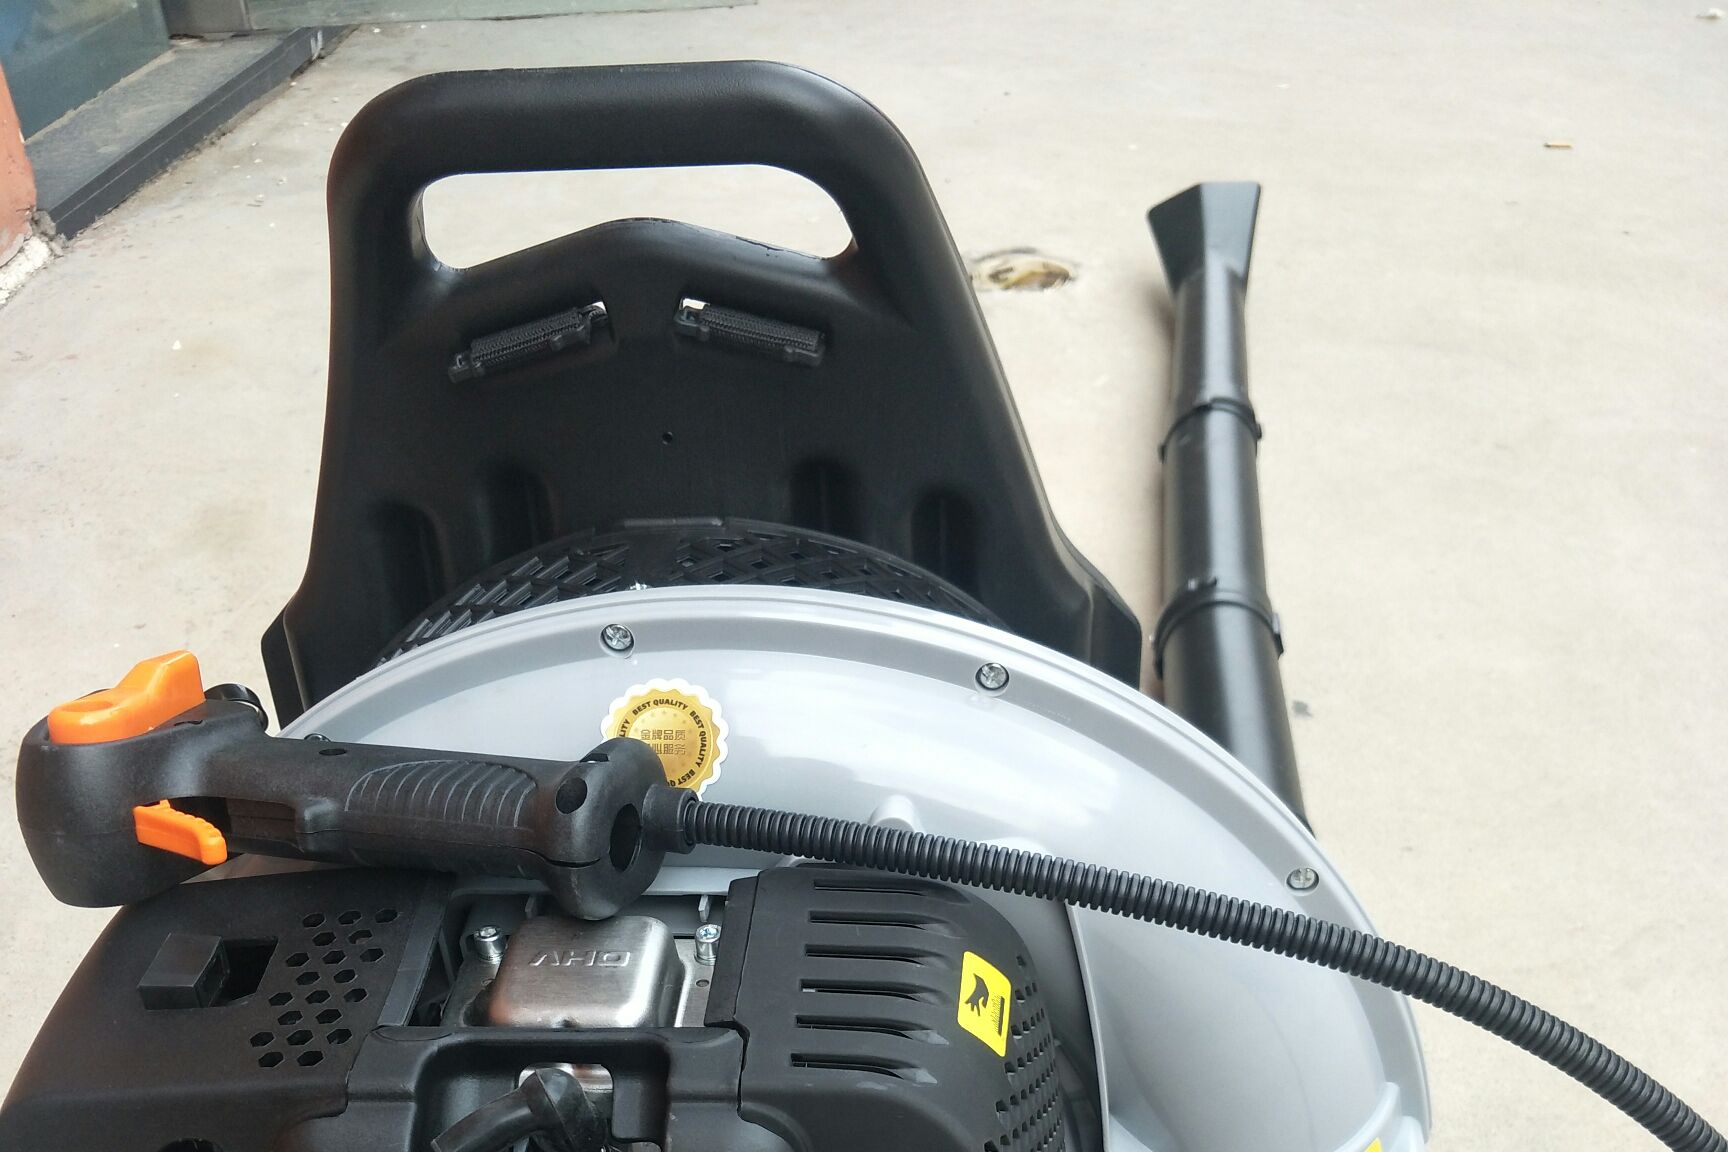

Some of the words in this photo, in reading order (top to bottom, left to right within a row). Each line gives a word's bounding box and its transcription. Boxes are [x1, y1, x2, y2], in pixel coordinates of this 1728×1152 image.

[632, 701, 651, 716] BEST
[653, 699, 688, 711] QUALITY
[619, 718, 631, 738] LITY
[689, 710, 704, 729] BEST
[641, 729, 686, 741] 金牌品质
[695, 731, 707, 768] QUALITY
[677, 769, 696, 786] BEST
